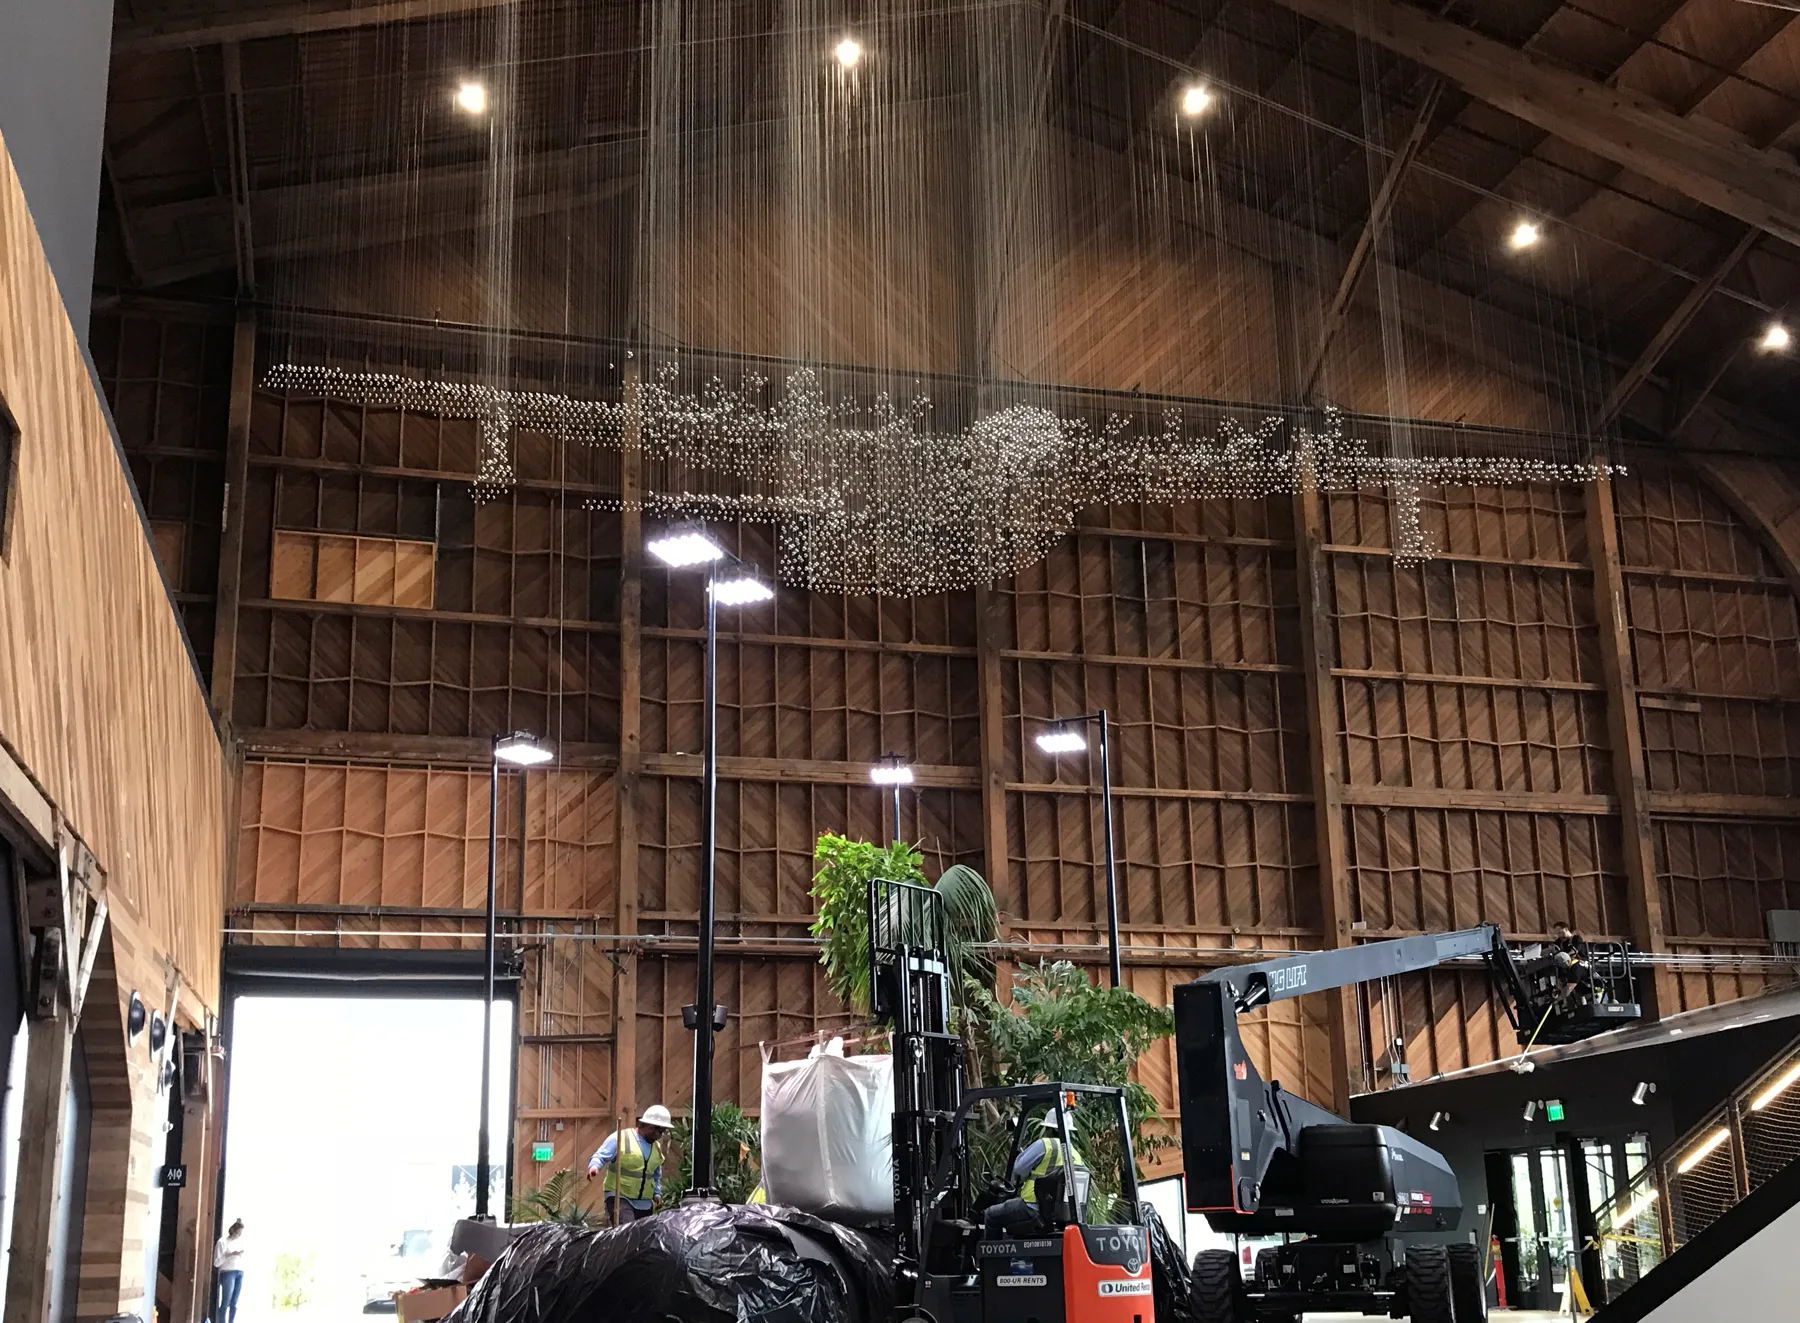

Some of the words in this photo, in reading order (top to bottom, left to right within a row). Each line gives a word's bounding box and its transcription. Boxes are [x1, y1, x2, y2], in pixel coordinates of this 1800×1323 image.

[1286, 964, 1307, 989] LIFT
[893, 1158, 901, 1204] TOYOTA
[980, 1244, 1017, 1254] TOYOTA
[1115, 1283, 1140, 1292] United
